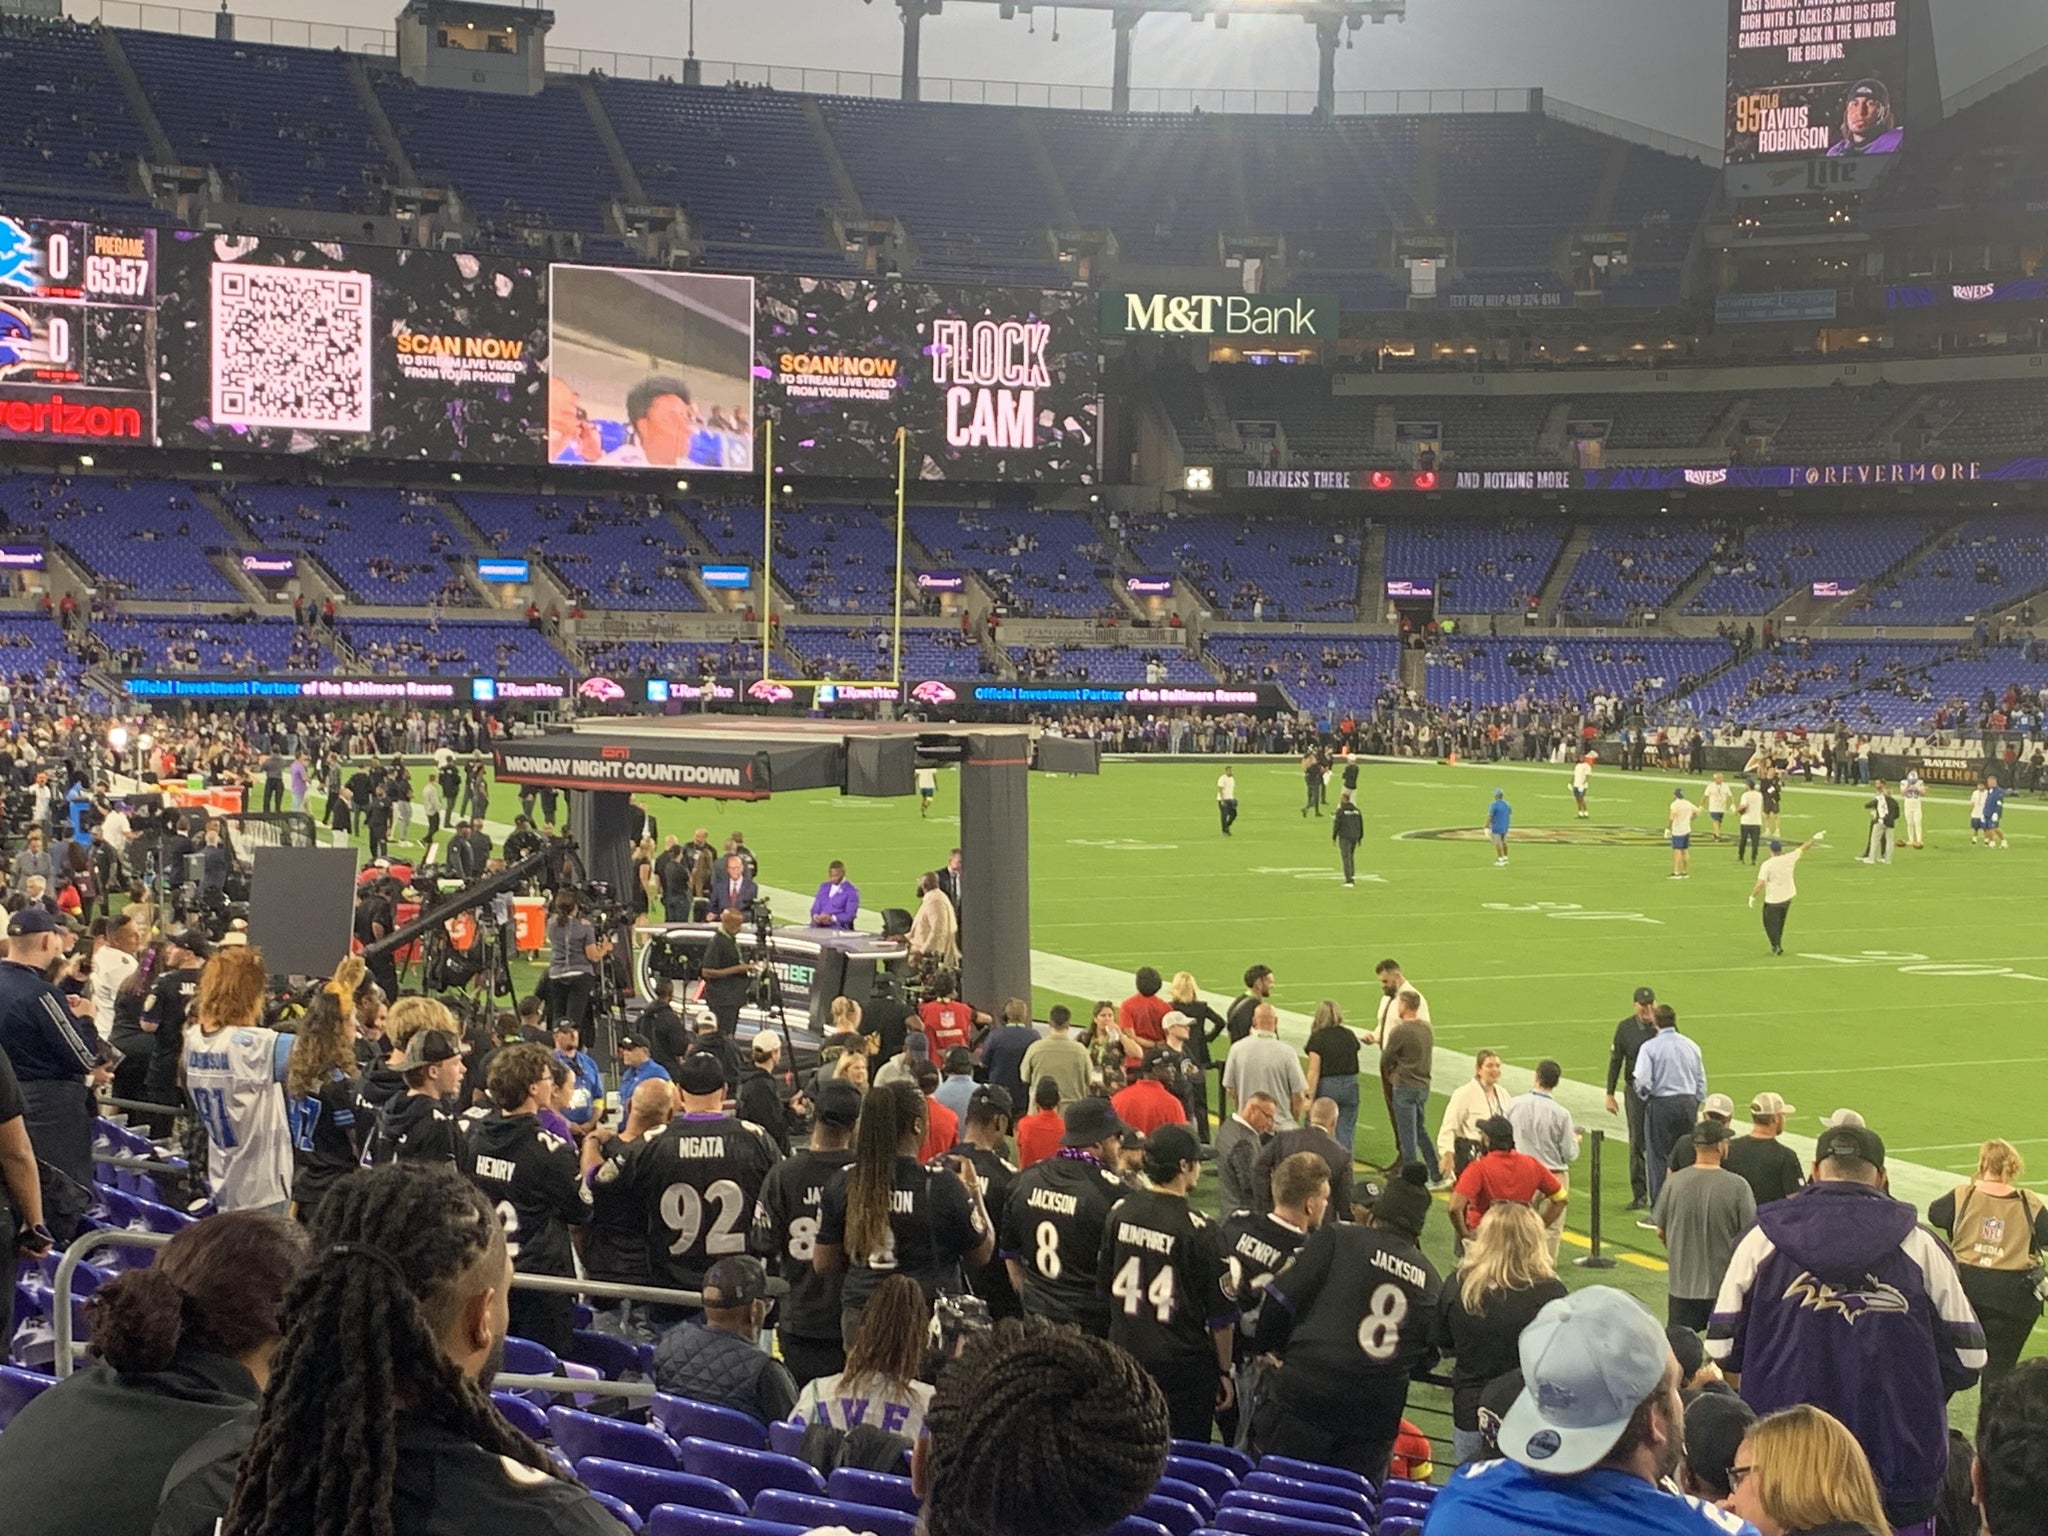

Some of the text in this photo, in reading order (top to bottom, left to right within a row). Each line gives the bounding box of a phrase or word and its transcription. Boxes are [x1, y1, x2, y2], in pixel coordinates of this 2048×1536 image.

[1740, 14, 1761, 30] HIGH
[1763, 11, 1785, 28] WITH
[1786, 11, 1794, 26] 6
[1795, 7, 1832, 25] TACKLES
[1834, 6, 1852, 23] AND
[1853, 4, 1868, 20] HIS
[1870, 2, 1896, 19] FIRST
[1738, 20, 1896, 48] CAREER STRIP SACK IN THE WIN OVER
[1788, 43, 1845, 62] THE BROWNS.
[1736, 94, 1760, 133] 95
[1759, 106, 1808, 130] TAVIUS
[1759, 126, 1829, 152] ROBINSON
[1805, 160, 1856, 190] Lite
[48, 234, 68, 279] 0
[94, 235, 145, 258] PREGAME
[86, 256, 149, 296] 63:57
[1952, 282, 1994, 301] RAVENS
[1124, 293, 1316, 335] M&T Bank
[48, 318, 68, 363] 0
[397, 334, 523, 359] SCAN NOW
[932, 319, 1051, 388] FLOCK
[396, 354, 524, 372] TO STREAM LIVE VIDEO
[404, 366, 516, 384] FROM YOUR PHONE!
[780, 354, 897, 377] SCAN NOW
[780, 374, 897, 388] TO STREAM LIVE VIDEO
[786, 386, 818, 397] FROM
[819, 387, 848, 398] YOUR
[0, 394, 141, 438] erizon
[946, 386, 1034, 448] CAM
[1247, 470, 1350, 488] DARKNESS THERE
[1456, 471, 1570, 488] AND NOTHING MORE
[1684, 468, 1727, 485] RAVENS
[1789, 462, 1981, 485] FOREVERMORE
[124, 679, 454, 696] Official Investment Partner of the Baltimore Ravens
[974, 687, 1258, 703] Official Investment Partner of the Baltimore Ravens
[504, 755, 740, 786] MONDAY NIGHT COUNTDOWN
[1922, 758, 1968, 769] RAVENS
[790, 964, 817, 984] BET
[679, 1136, 725, 1159] NGATA
[476, 1154, 516, 1182] HENRY
[1027, 1187, 1077, 1217] JACKSON
[660, 1178, 746, 1255] 92
[1036, 1220, 1063, 1281] 8
[1117, 1221, 1176, 1256] HUMPHREY
[1235, 1232, 1282, 1269] HENRY
[1974, 1243, 2004, 1258] MEDIA
[1370, 1249, 1427, 1290] JACKSON
[1111, 1255, 1176, 1324] 44
[1358, 1282, 1408, 1359] 8
